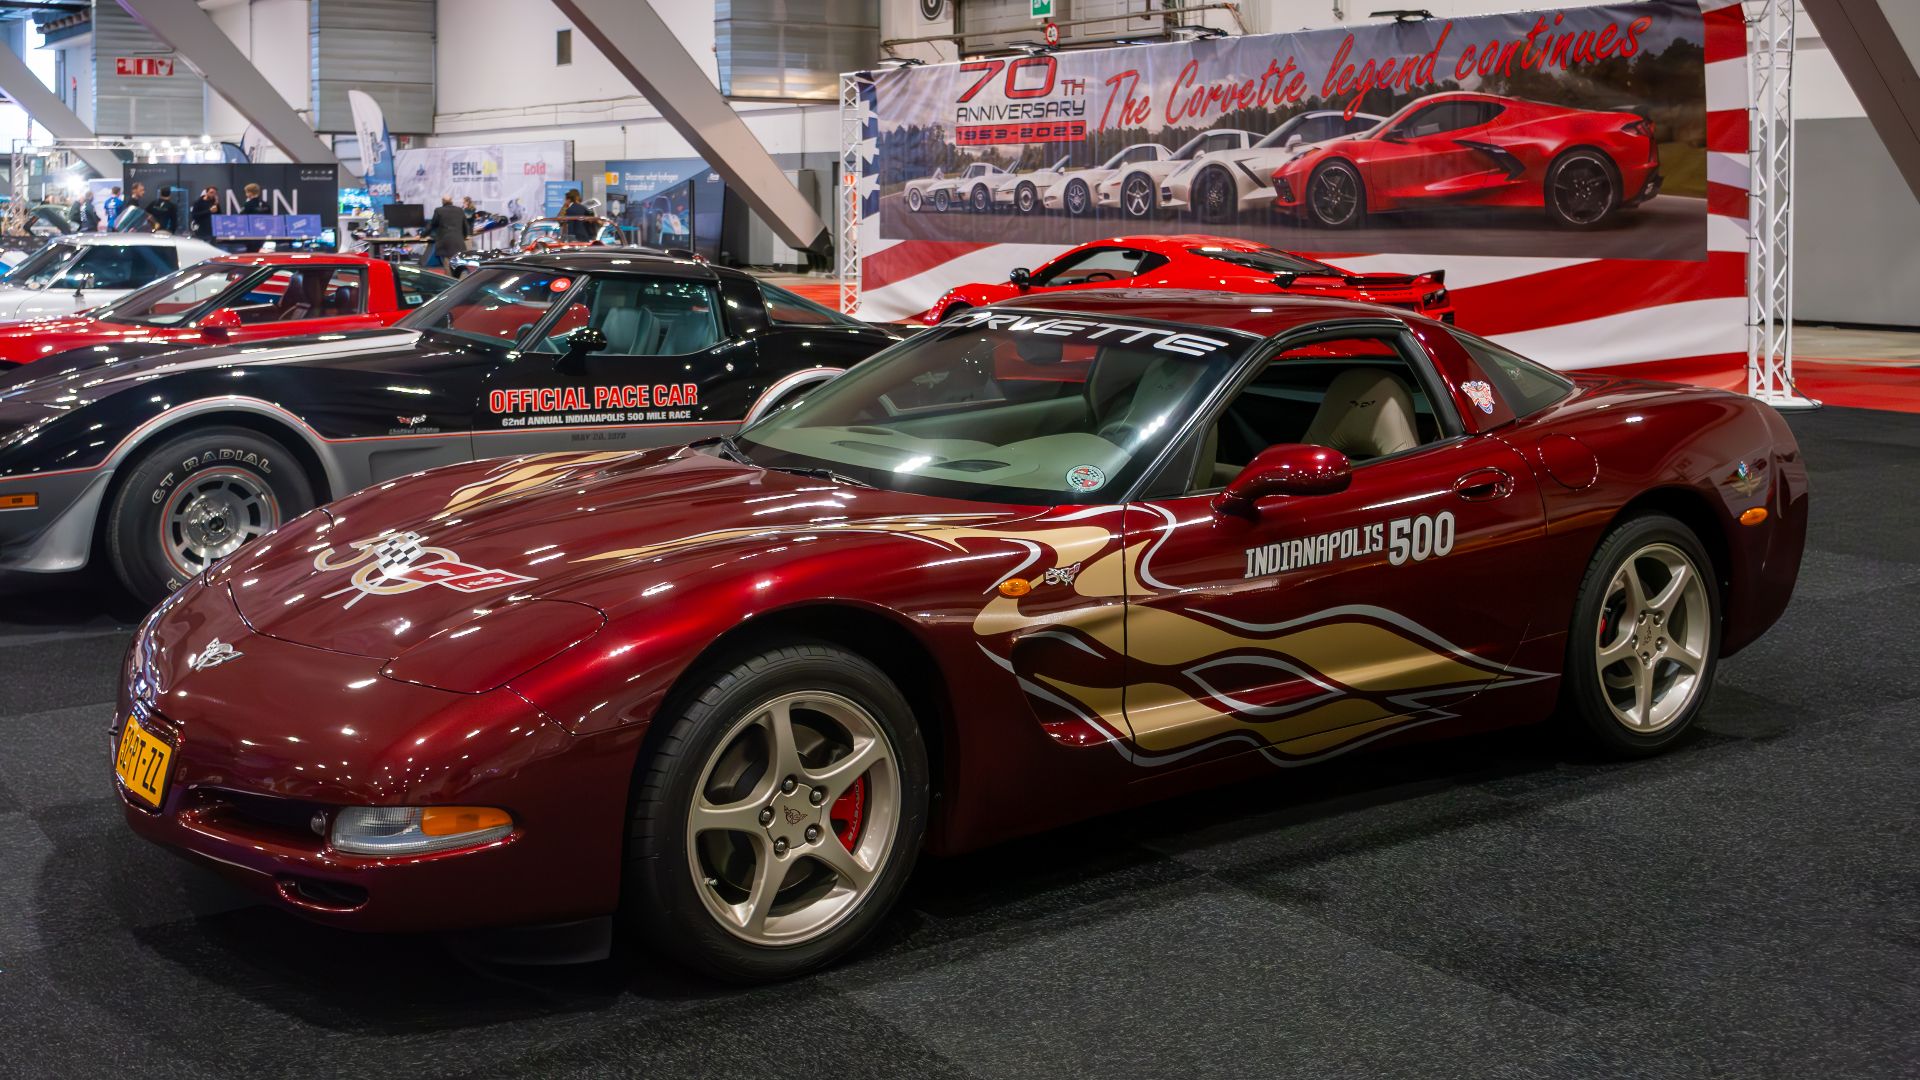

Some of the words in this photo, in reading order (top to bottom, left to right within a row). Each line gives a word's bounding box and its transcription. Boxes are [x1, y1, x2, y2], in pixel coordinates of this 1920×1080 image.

[1099, 69, 1152, 135] The
[1165, 56, 1307, 124] Corvette
[1321, 22, 1453, 121] legend
[1455, 13, 1653, 80] continues
[956, 100, 1086, 122] ANNIVERSARY
[957, 126, 1084, 141] 1953-2023
[940, 311, 1229, 357] ORVETTE
[490, 387, 591, 414] OFFICIAL
[594, 384, 650, 409] PACE
[653, 382, 698, 407] CAR
[502, 416, 526, 427] 62nd
[527, 415, 564, 426] ANNUAL
[565, 412, 625, 424] INDIANAPOLIS
[627, 412, 645, 421] 500
[646, 411, 668, 420] MILE
[669, 410, 691, 420] RACE
[182, 449, 272, 474] RADIAL
[1243, 522, 1384, 579] INDIANAPOLIS
[1388, 510, 1456, 567] 500
